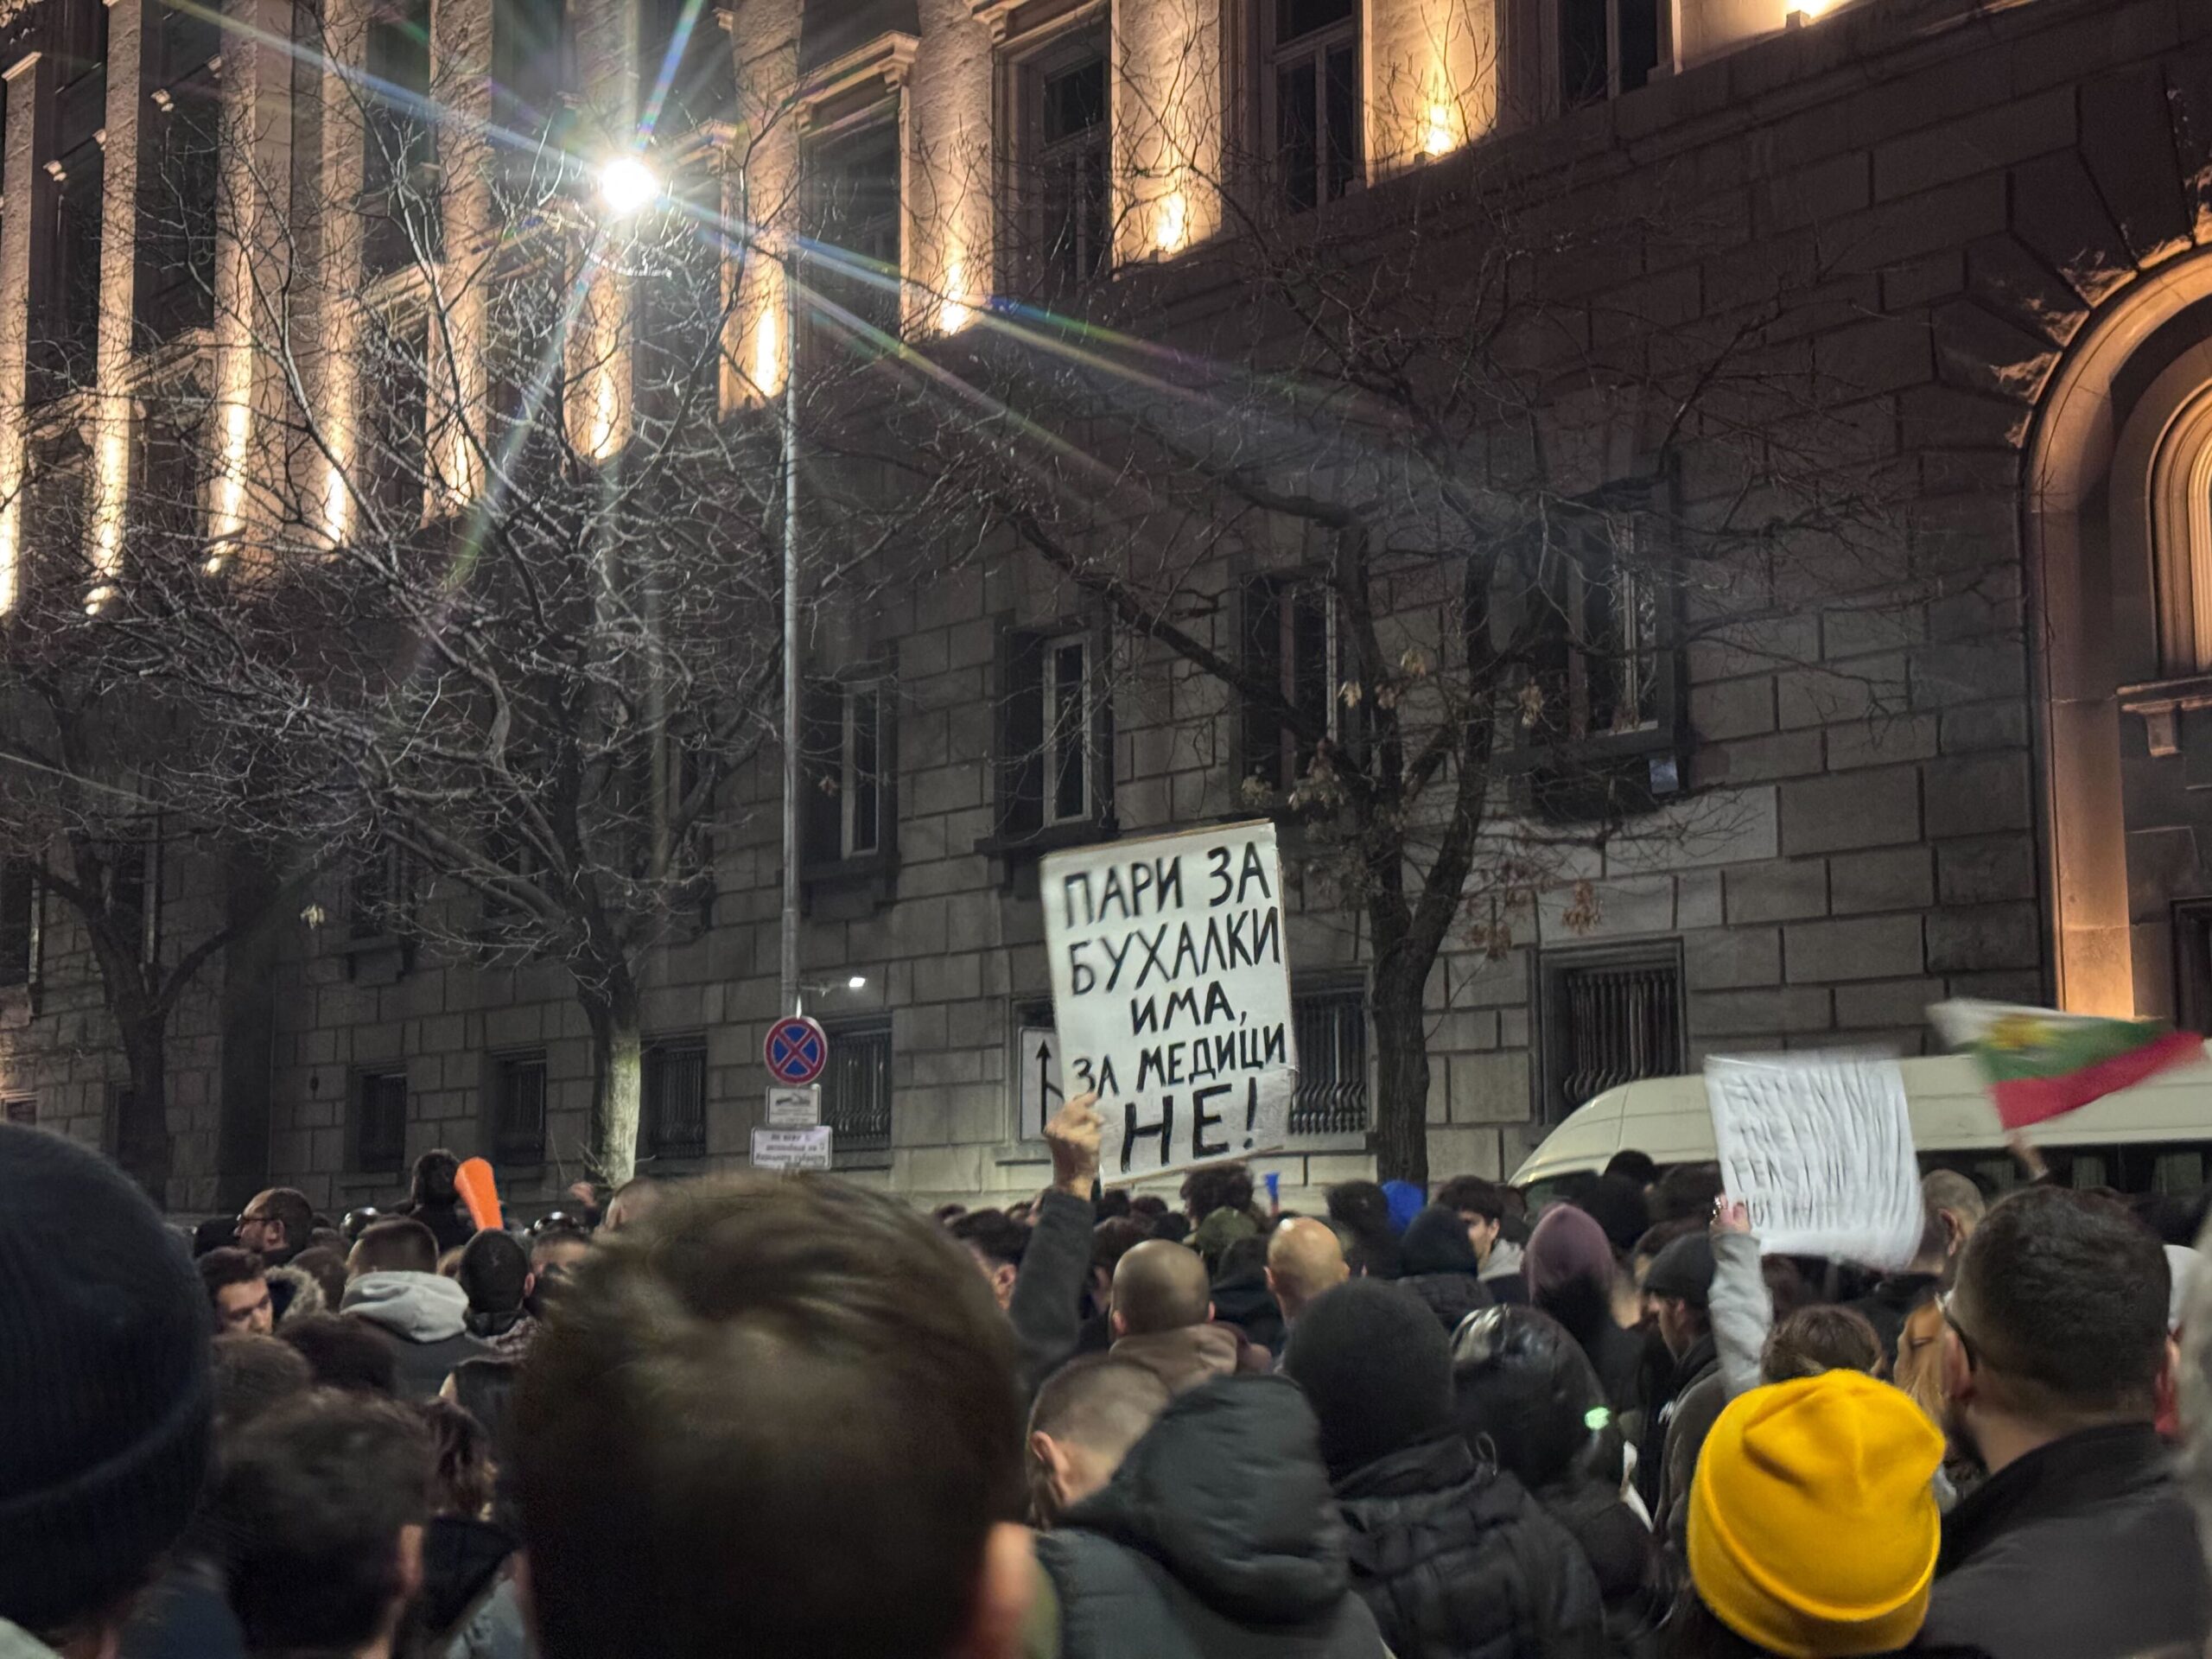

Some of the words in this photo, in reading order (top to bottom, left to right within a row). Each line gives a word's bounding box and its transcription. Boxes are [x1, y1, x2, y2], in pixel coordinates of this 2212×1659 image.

[1064, 855, 1183, 928] ПАРИ
[1207, 842, 1272, 907] ЗА
[1069, 906, 1281, 996] БУХАЛКИ
[1130, 981, 1248, 1035] ИМА,
[1071, 1054, 1119, 1098] ЗА
[1137, 1022, 1287, 1092] МЕДИЦИ
[1121, 1077, 1257, 1173] НЕ!
